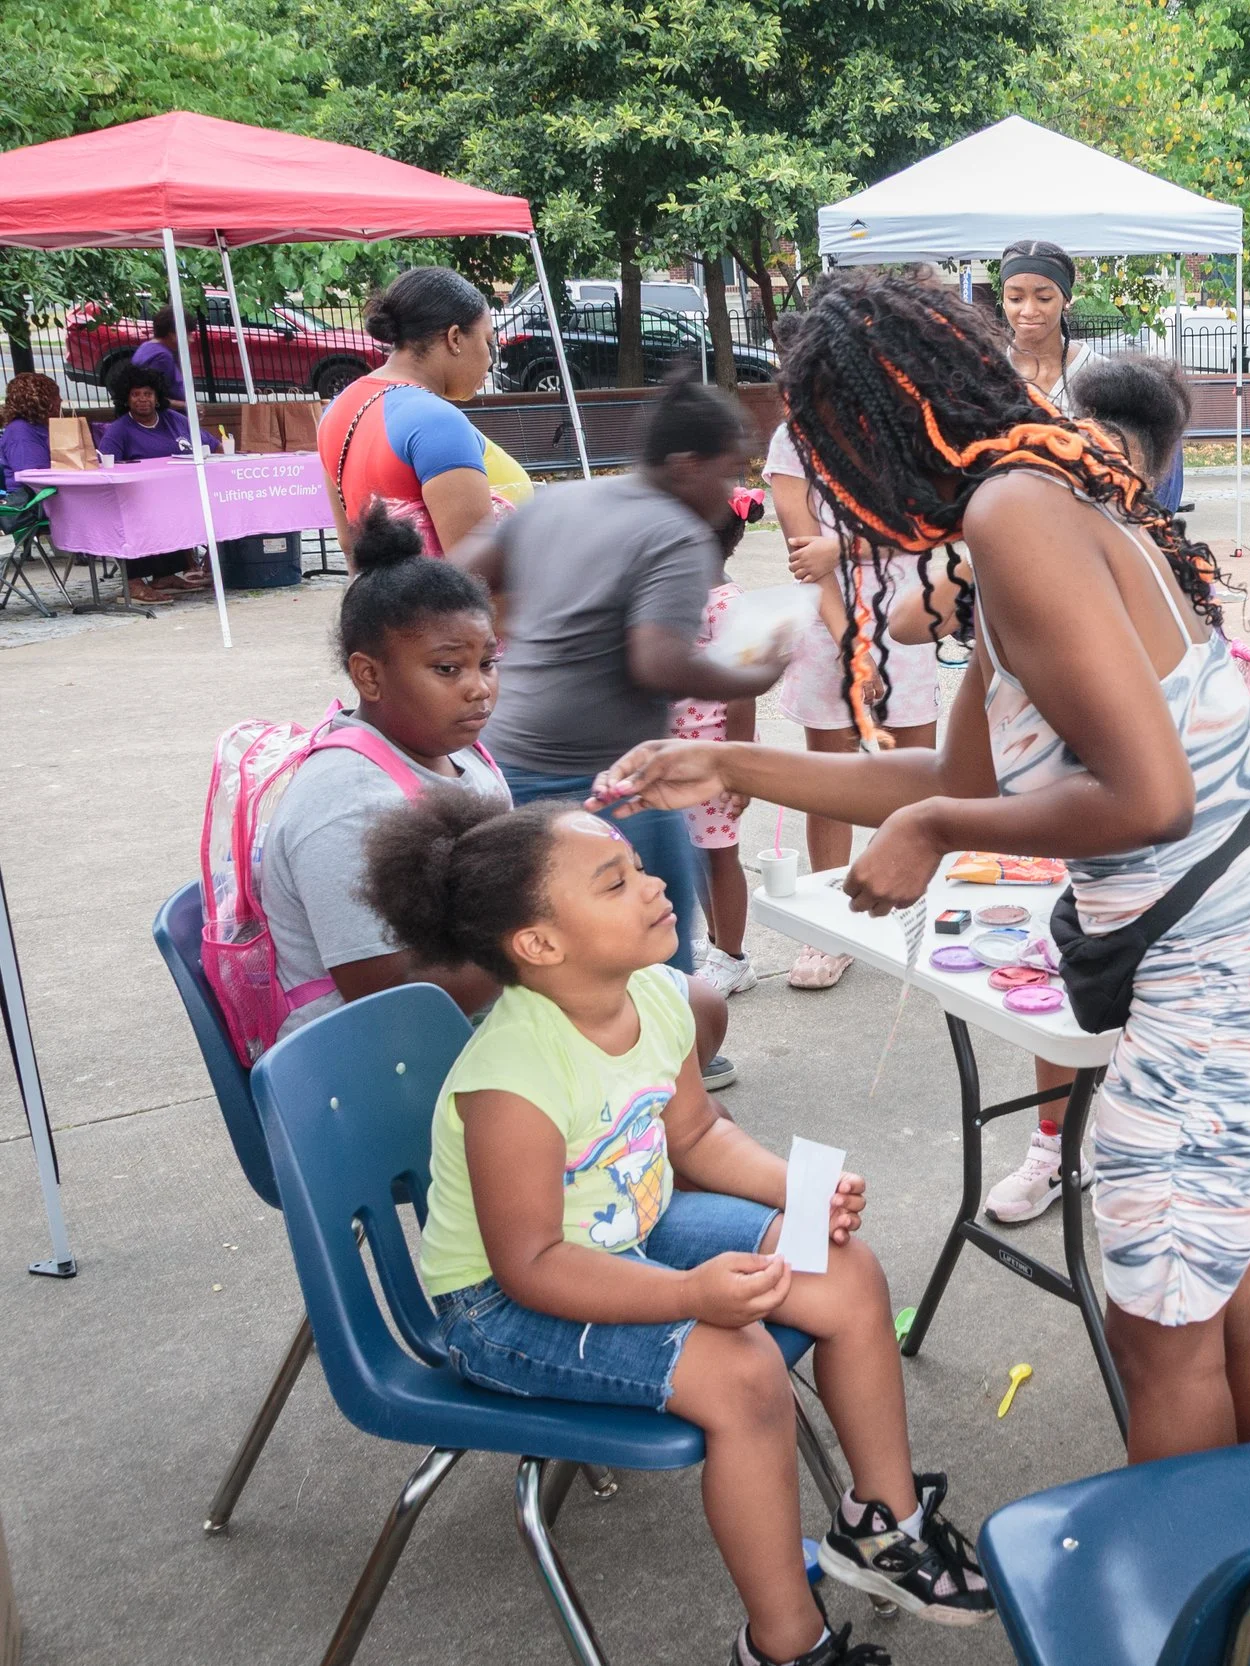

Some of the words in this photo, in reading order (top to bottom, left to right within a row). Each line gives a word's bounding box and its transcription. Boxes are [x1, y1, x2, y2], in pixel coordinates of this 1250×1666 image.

[231, 467, 270, 480] "ECCC
[272, 465, 305, 478] 1910"
[213, 489, 255, 503] "Lifting
[256, 489, 267, 498] as
[269, 486, 287, 497] We
[288, 484, 322, 496] Climb"
